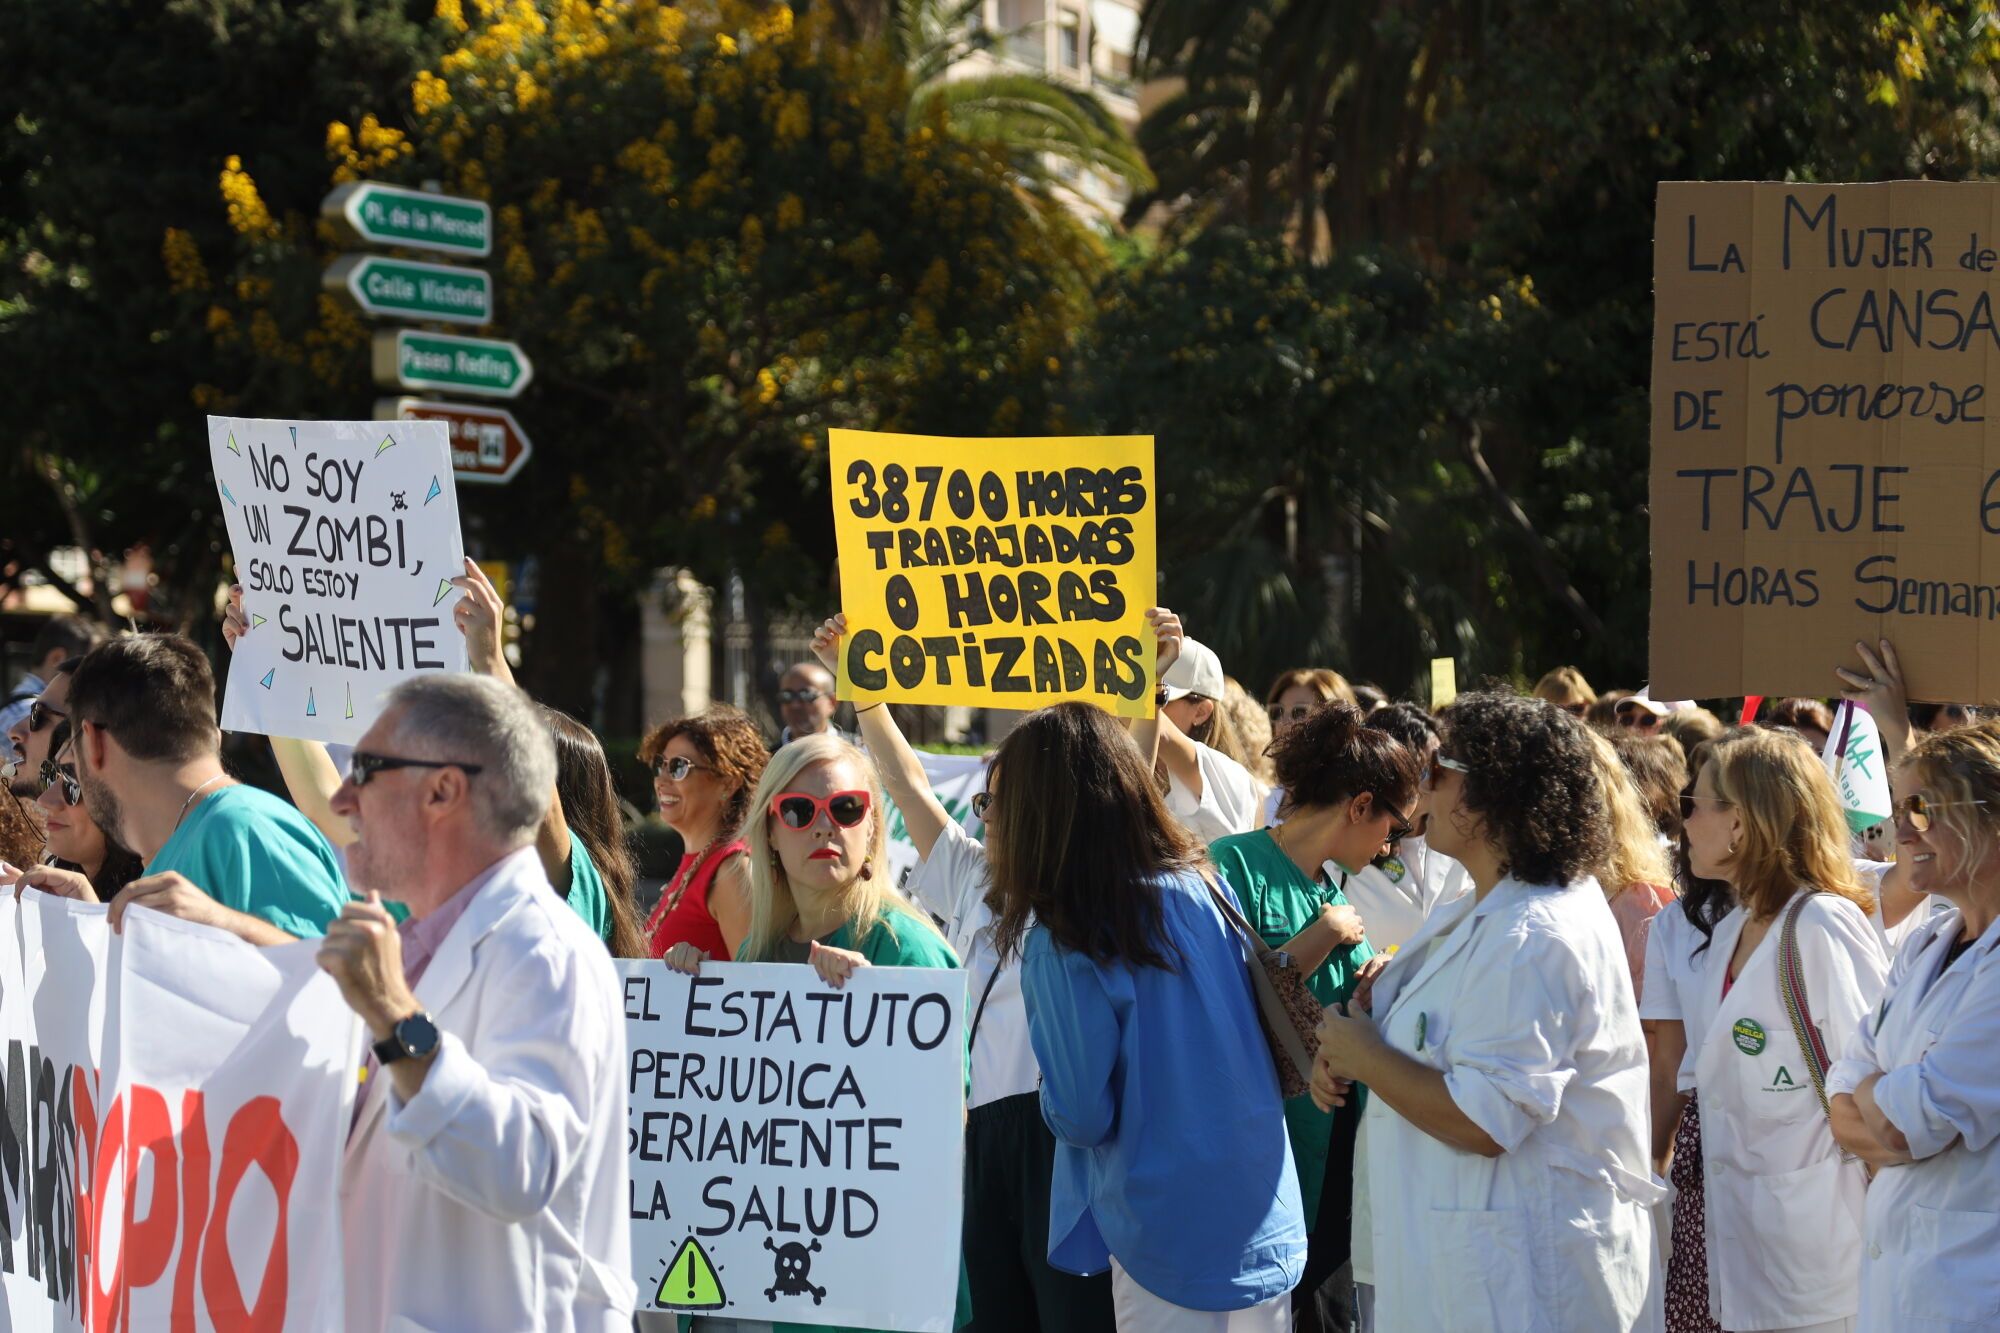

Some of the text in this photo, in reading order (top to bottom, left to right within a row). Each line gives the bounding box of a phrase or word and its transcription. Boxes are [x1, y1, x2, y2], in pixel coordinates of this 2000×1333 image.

[389, 206, 410, 229] de
[411, 207, 428, 231] la
[429, 211, 486, 240] Merced
[1783, 193, 1934, 270] MUJER
[1959, 232, 1998, 272] de
[367, 272, 486, 310] Calle Victoria
[401, 344, 513, 384] Paseo Reding
[1674, 381, 1985, 465] DE ponerse
[249, 443, 363, 503] NO SOY
[847, 459, 1147, 523] 38700 HORAS
[1676, 464, 1909, 533] TRAJE
[243, 504, 271, 545] UN
[866, 517, 1135, 570] TRABAJADAS
[249, 558, 358, 600] SOLO ESTOY
[941, 569, 1126, 628] HORAS
[1688, 555, 2000, 620] HORAS Seman
[279, 604, 444, 671] SALIENTE
[624, 977, 951, 1050] EL ESTATUTO
[1733, 1024, 1764, 1040] HUELGA
[630, 1048, 866, 1109] PERJUDICA
[629, 1176, 879, 1238] LA SALUD
